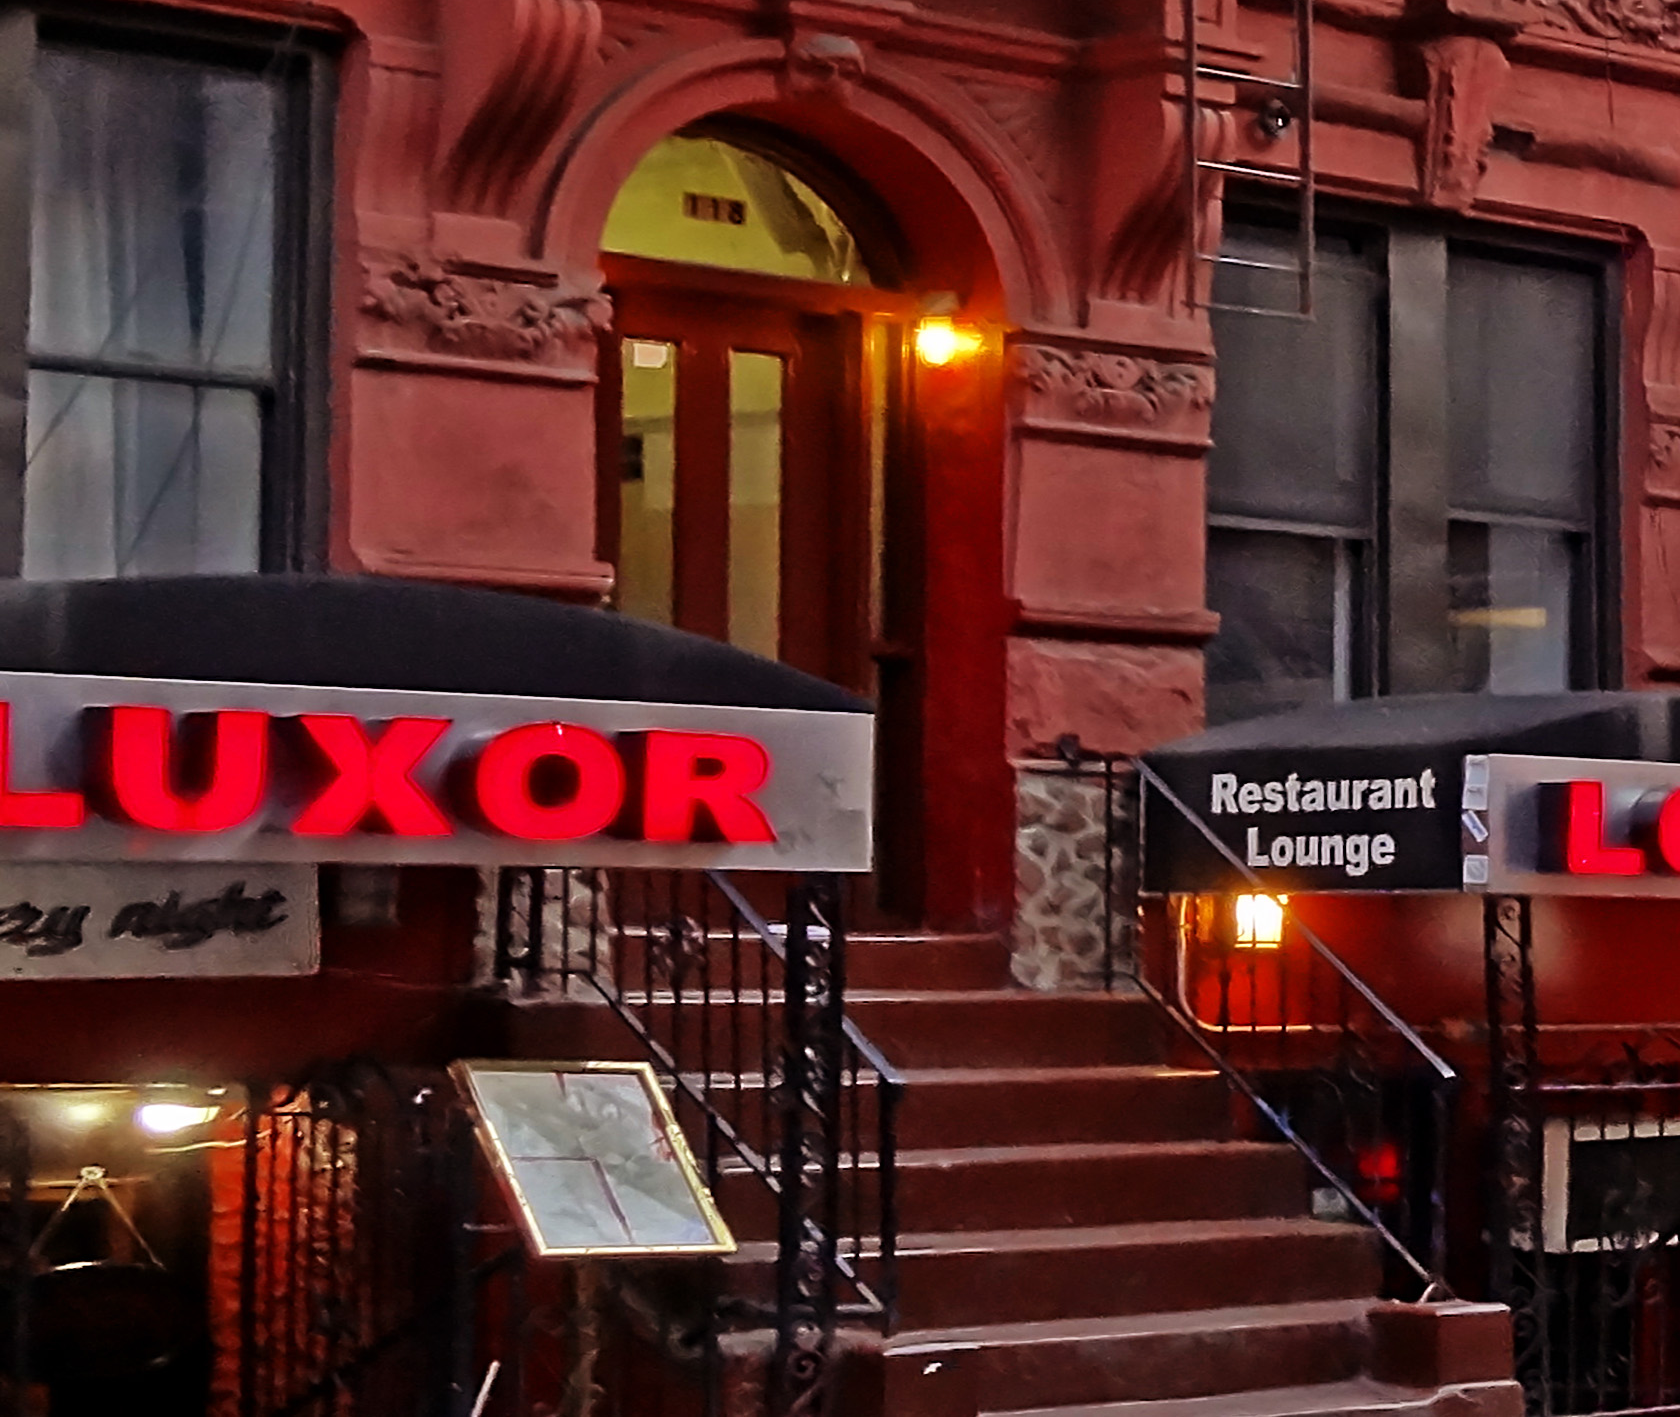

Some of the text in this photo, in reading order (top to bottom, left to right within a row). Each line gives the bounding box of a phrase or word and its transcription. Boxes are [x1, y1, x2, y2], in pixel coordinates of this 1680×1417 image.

[0, 700, 777, 843] LUXOR
[1210, 768, 1437, 814] Restaurant
[1247, 827, 1396, 877] Lounge
